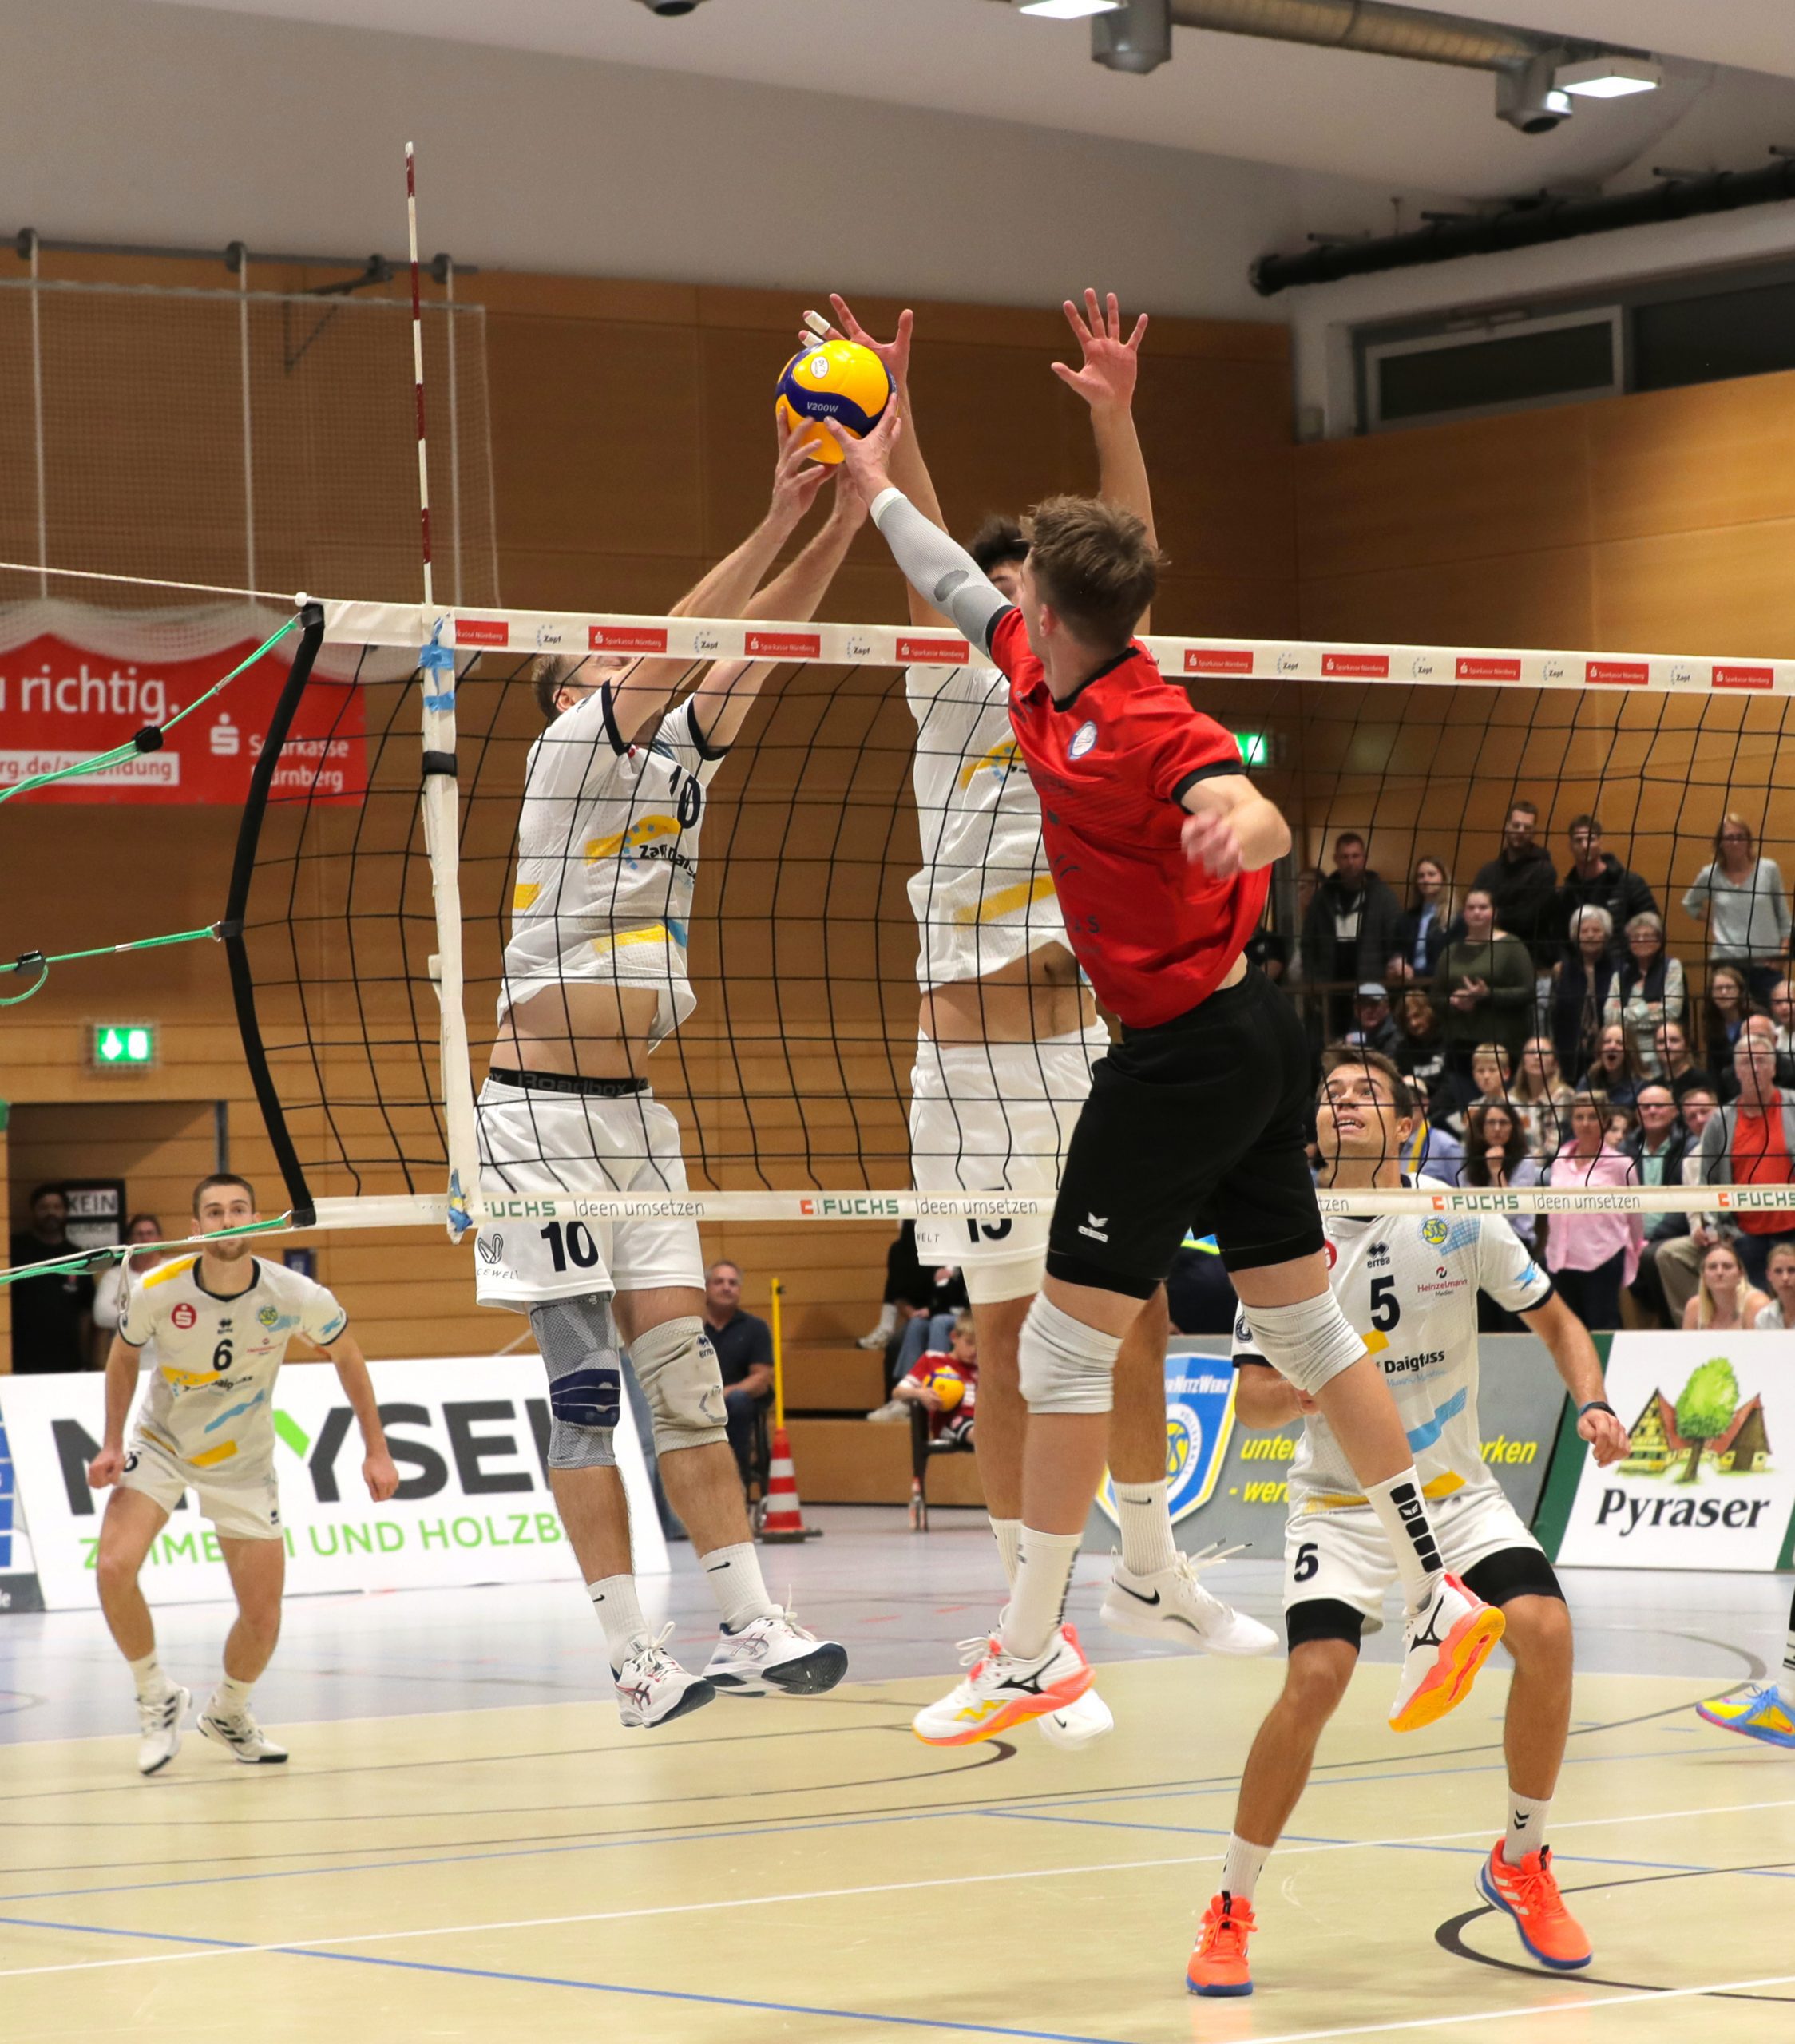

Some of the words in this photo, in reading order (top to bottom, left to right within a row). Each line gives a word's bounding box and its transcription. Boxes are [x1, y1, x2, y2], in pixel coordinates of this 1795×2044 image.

[806, 402, 838, 413] V200W
[544, 635, 561, 644] Zapf
[700, 640, 718, 650] Zapf
[853, 647, 870, 656] Zapf
[1282, 662, 1298, 671] Zapf
[1417, 666, 1432, 675] Zapf
[1548, 669, 1563, 679] Zapf
[1676, 674, 1690, 683] Zapf
[21, 664, 180, 727] richtig.
[248, 734, 349, 757] Sarkasse
[252, 764, 343, 793] ürnberg
[669, 765, 701, 829] 10
[519, 1073, 626, 1095] Roadbox
[823, 1198, 900, 1215] FUCHS
[916, 1198, 958, 1215] Ideen
[962, 1198, 1038, 1214] umsetzen
[1318, 1197, 1349, 1212] tzen
[1452, 1194, 1519, 1210] FUCHS
[1533, 1194, 1571, 1210] Ideen
[1575, 1194, 1641, 1210] umsetzen
[1737, 1192, 1795, 1207] FUCHS
[484, 1200, 557, 1218] UCHS
[573, 1200, 620, 1217] Ideen
[624, 1199, 705, 1216] umsetzen
[540, 1221, 599, 1273] 10
[1367, 1256, 1390, 1269] errea
[1417, 1278, 1468, 1293] Heinzelmann
[1370, 1274, 1401, 1332] 5
[213, 1338, 234, 1371] 6
[1479, 1435, 1538, 1464] rken
[1595, 1487, 1771, 1537] Pyraser
[309, 1522, 405, 1556] UND
[419, 1513, 569, 1550] HOLZB
[1294, 1542, 1319, 1583] 5
